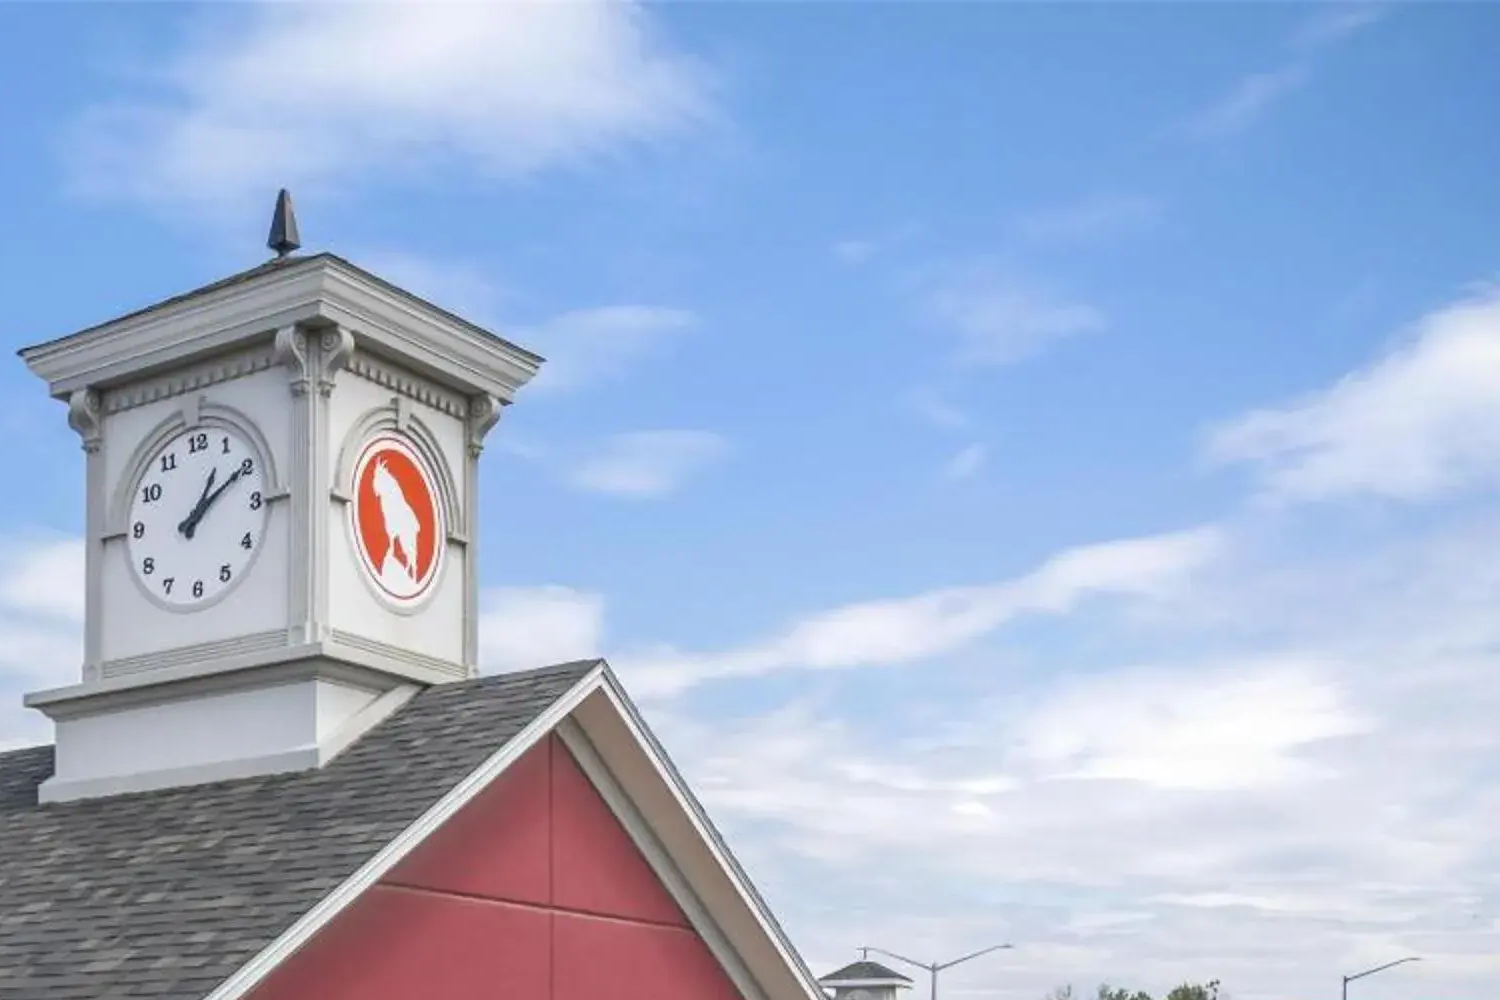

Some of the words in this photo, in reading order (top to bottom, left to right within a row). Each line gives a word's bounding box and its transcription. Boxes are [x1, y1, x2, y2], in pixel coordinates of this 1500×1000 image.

[188, 433, 209, 455] 12
[222, 437, 230, 454] 1
[161, 454, 177, 473] 11
[242, 458, 254, 476] 2
[142, 484, 163, 503] 10
[250, 491, 262, 511] 3
[133, 521, 145, 539] 9
[241, 531, 253, 550] 4
[143, 557, 155, 575] 8
[219, 564, 231, 583] 5
[163, 578, 175, 595] 7
[193, 580, 204, 598] 6
